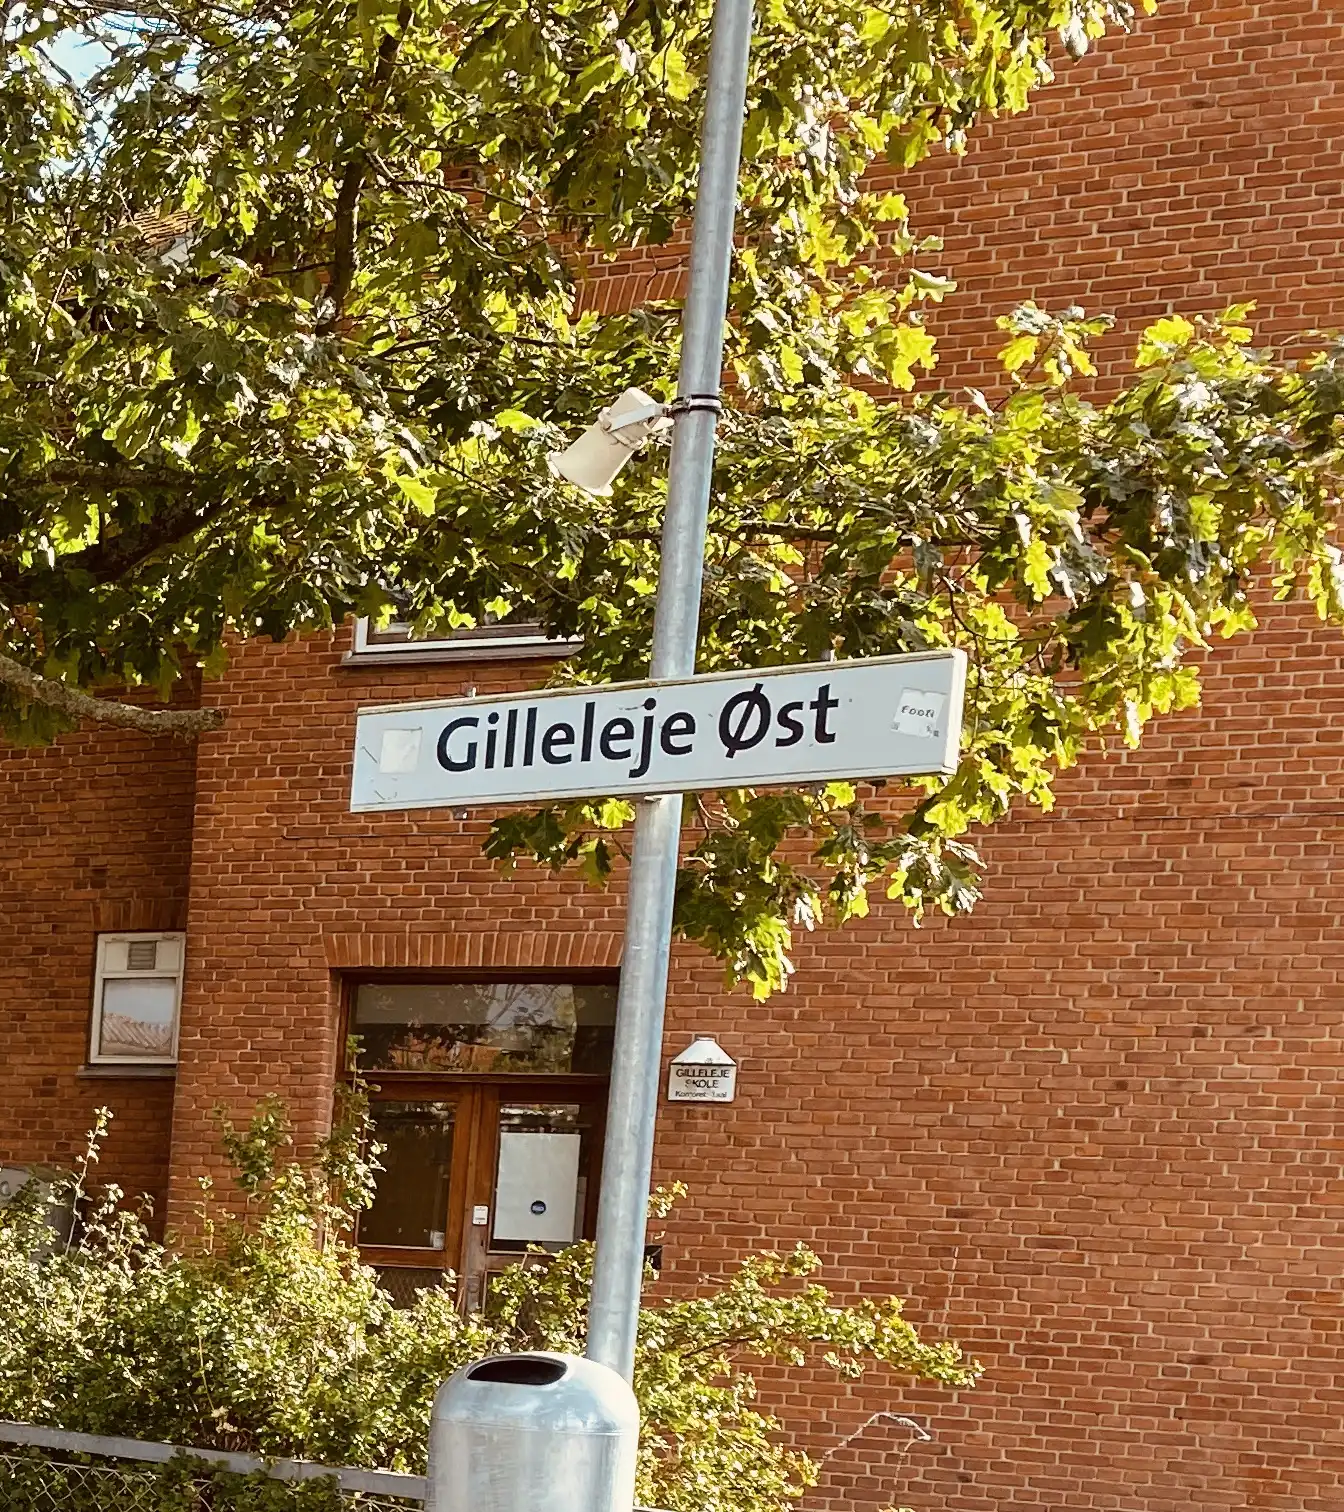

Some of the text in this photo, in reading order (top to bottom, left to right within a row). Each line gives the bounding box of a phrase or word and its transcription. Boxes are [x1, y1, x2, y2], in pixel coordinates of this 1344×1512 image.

[435, 682, 840, 778] Gilleleje Øst
[676, 1069, 730, 1078] GILLELEJE
